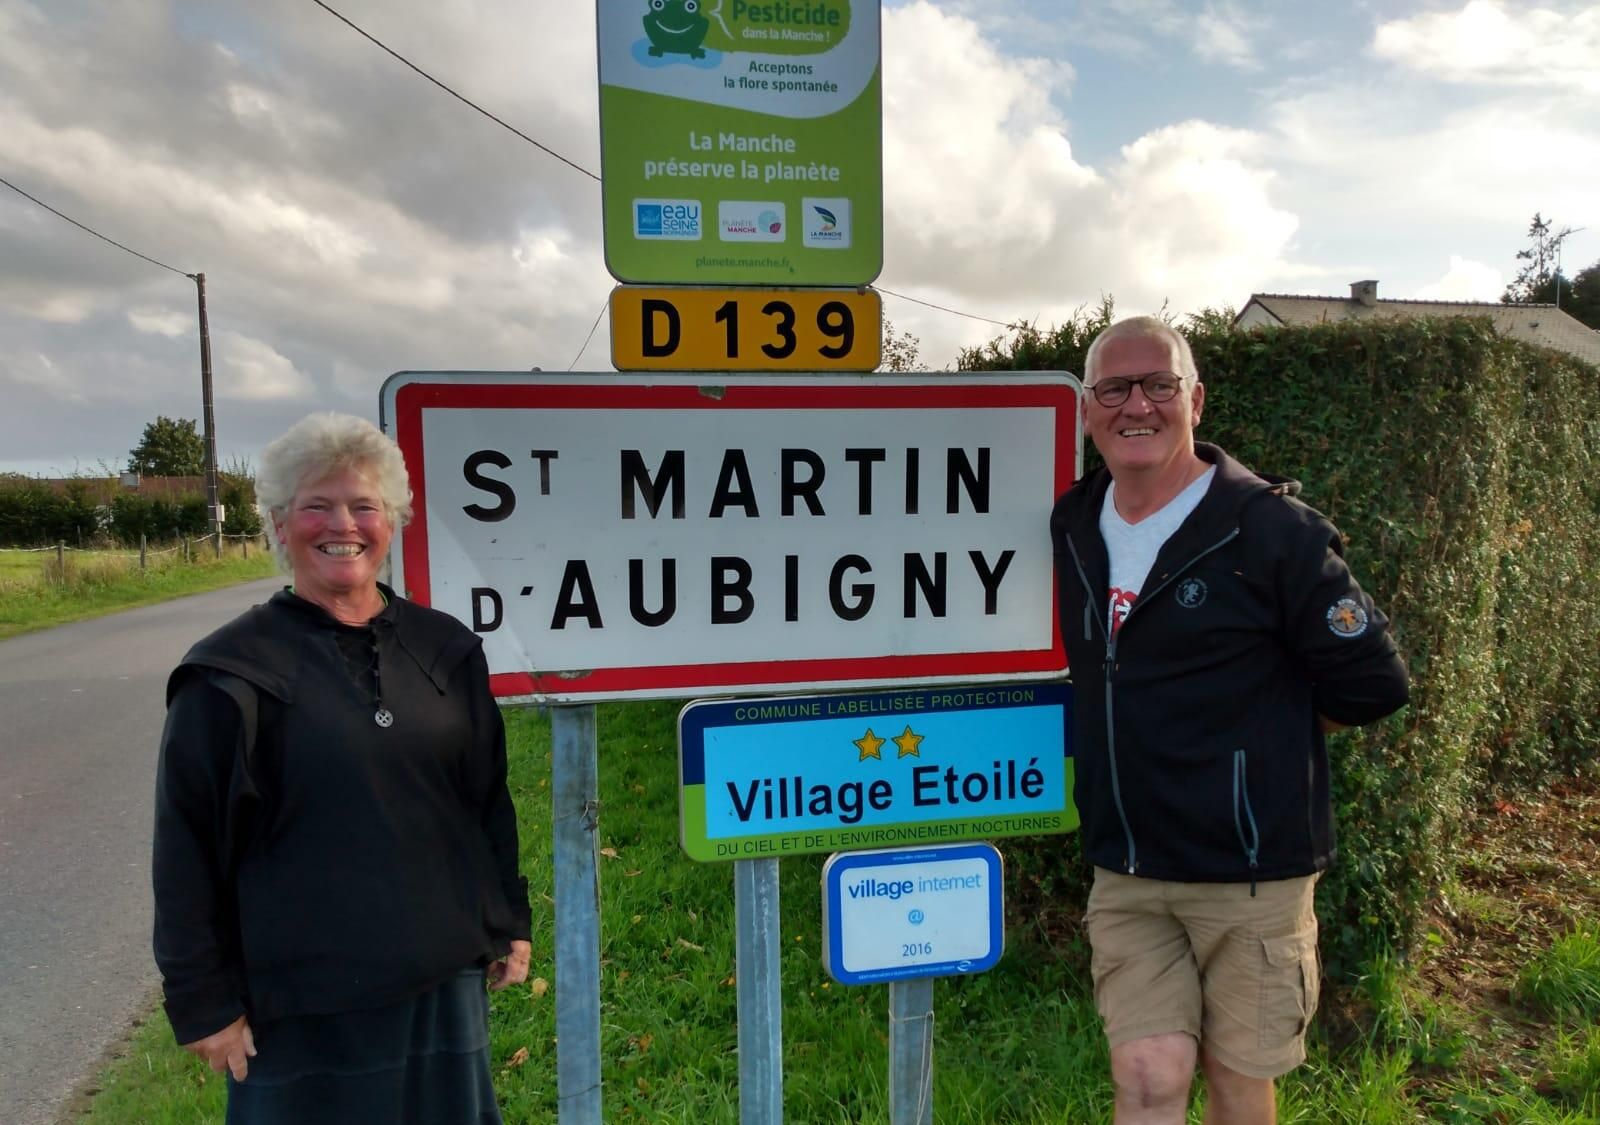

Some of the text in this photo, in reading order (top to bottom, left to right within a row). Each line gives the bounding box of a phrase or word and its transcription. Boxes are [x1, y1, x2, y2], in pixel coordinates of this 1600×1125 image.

[732, 0, 840, 26] Pesticide
[742, 26, 768, 39] dans
[769, 27, 779, 40] la
[781, 28, 824, 41] Manche
[749, 60, 813, 75] Acceptons
[723, 75, 838, 93] la flore spontanée
[690, 132, 796, 153] La Manche
[644, 157, 840, 183] préserve la planète
[642, 299, 855, 359] D 139
[620, 447, 991, 519] MARTIN
[735, 689, 1034, 720] COMMUNE LABELLISÉE PROTECTION
[727, 757, 1045, 824] Village Etoilé
[717, 816, 1061, 856] DU CIEL ET DE L'ENVIRONNEMENT NOCTURNES
[848, 873, 982, 900] village internet
[902, 942, 932, 957] 2016
